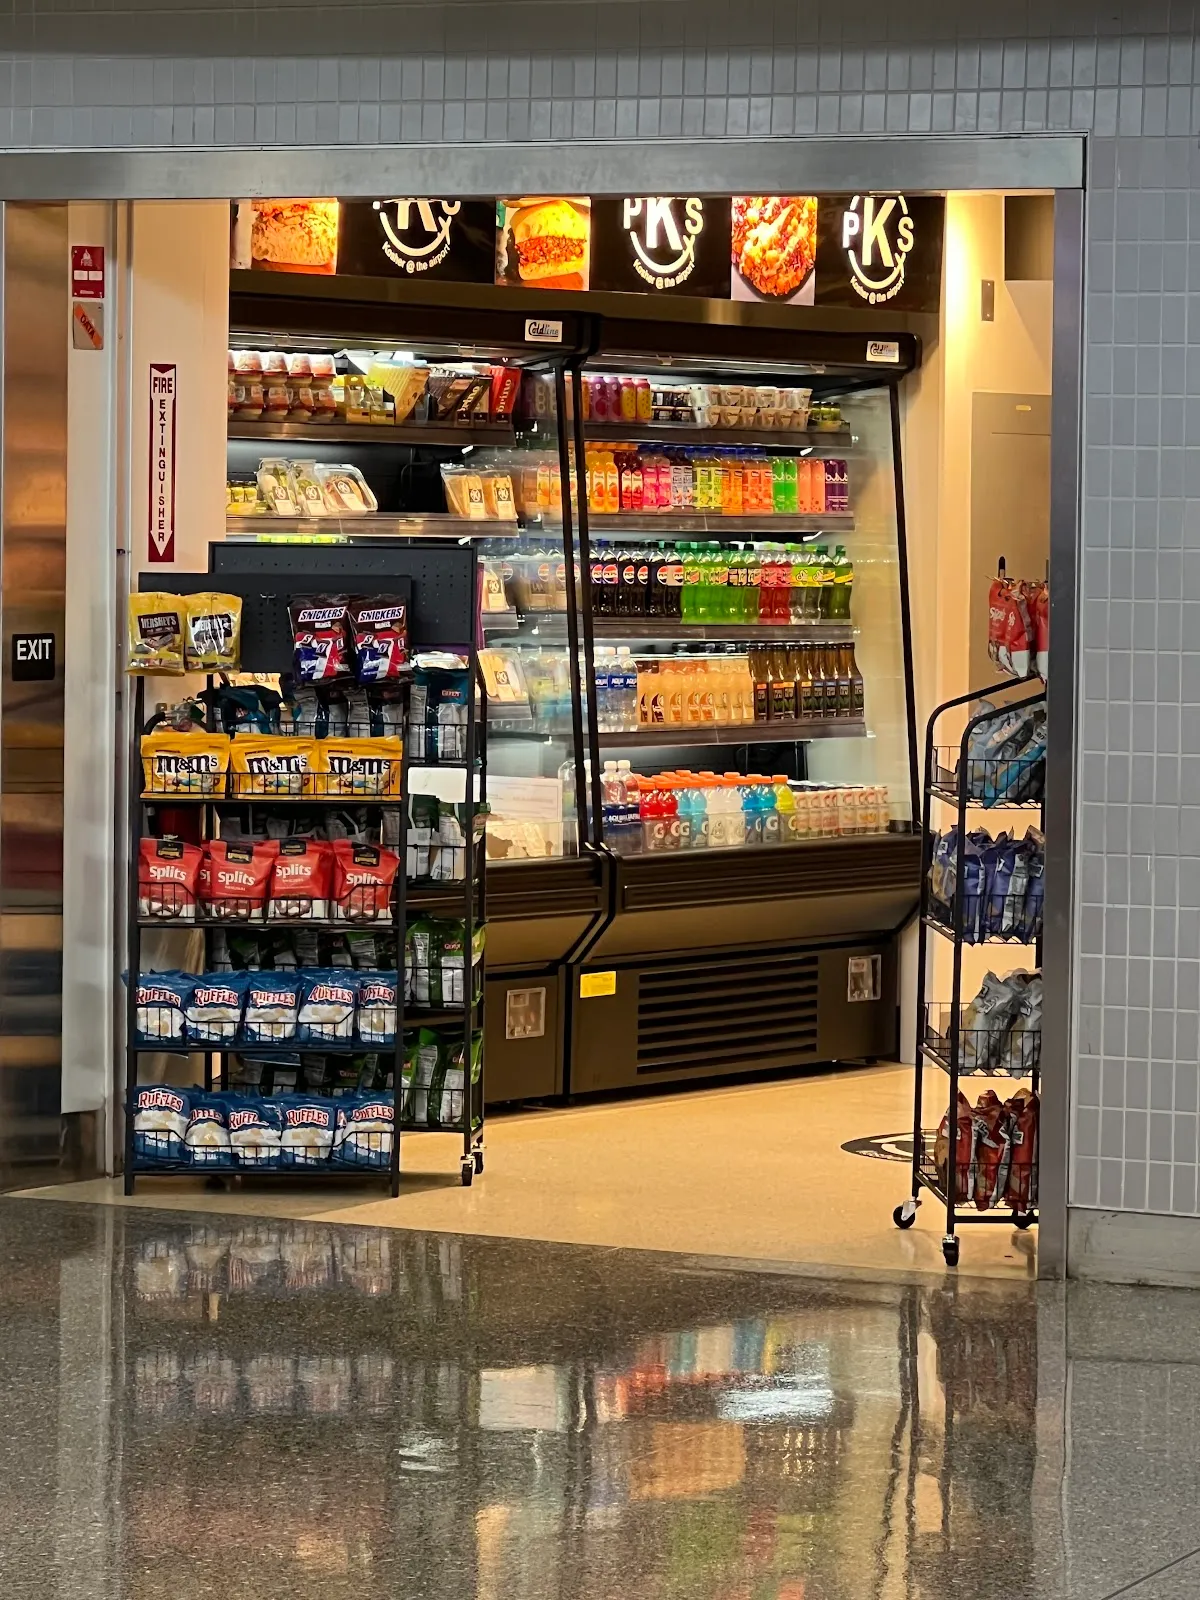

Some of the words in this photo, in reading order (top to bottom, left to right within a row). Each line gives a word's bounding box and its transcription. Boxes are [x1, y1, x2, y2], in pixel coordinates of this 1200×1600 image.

[842, 197, 914, 267] PKS
[416, 261, 428, 271] the
[429, 243, 450, 267] airport
[81, 314, 95, 339] DATA
[153, 377, 173, 393] FIRE
[158, 399, 166, 542] EXTINGUISHER
[141, 615, 177, 629] HERSHEY'S
[302, 607, 344, 621] SNICKERS
[360, 607, 402, 621] SNICKERS
[17, 638, 52, 660] EXIT
[654, 823, 664, 838] G
[766, 815, 778, 830] G
[149, 866, 187, 880] Splits
[217, 871, 256, 886] Splits
[276, 863, 312, 878] Splits
[346, 873, 384, 885] Splits
[136, 987, 181, 1006] RUFFLES
[195, 989, 239, 1006] RUFFLES
[251, 991, 295, 1007] RUFFLES
[308, 985, 353, 1003] RUFFLES
[358, 985, 395, 1005] RUFFLES
[138, 1091, 183, 1111] RUFFLES
[190, 1109, 223, 1121] UFFLES
[286, 1109, 329, 1126] RUFFLES
